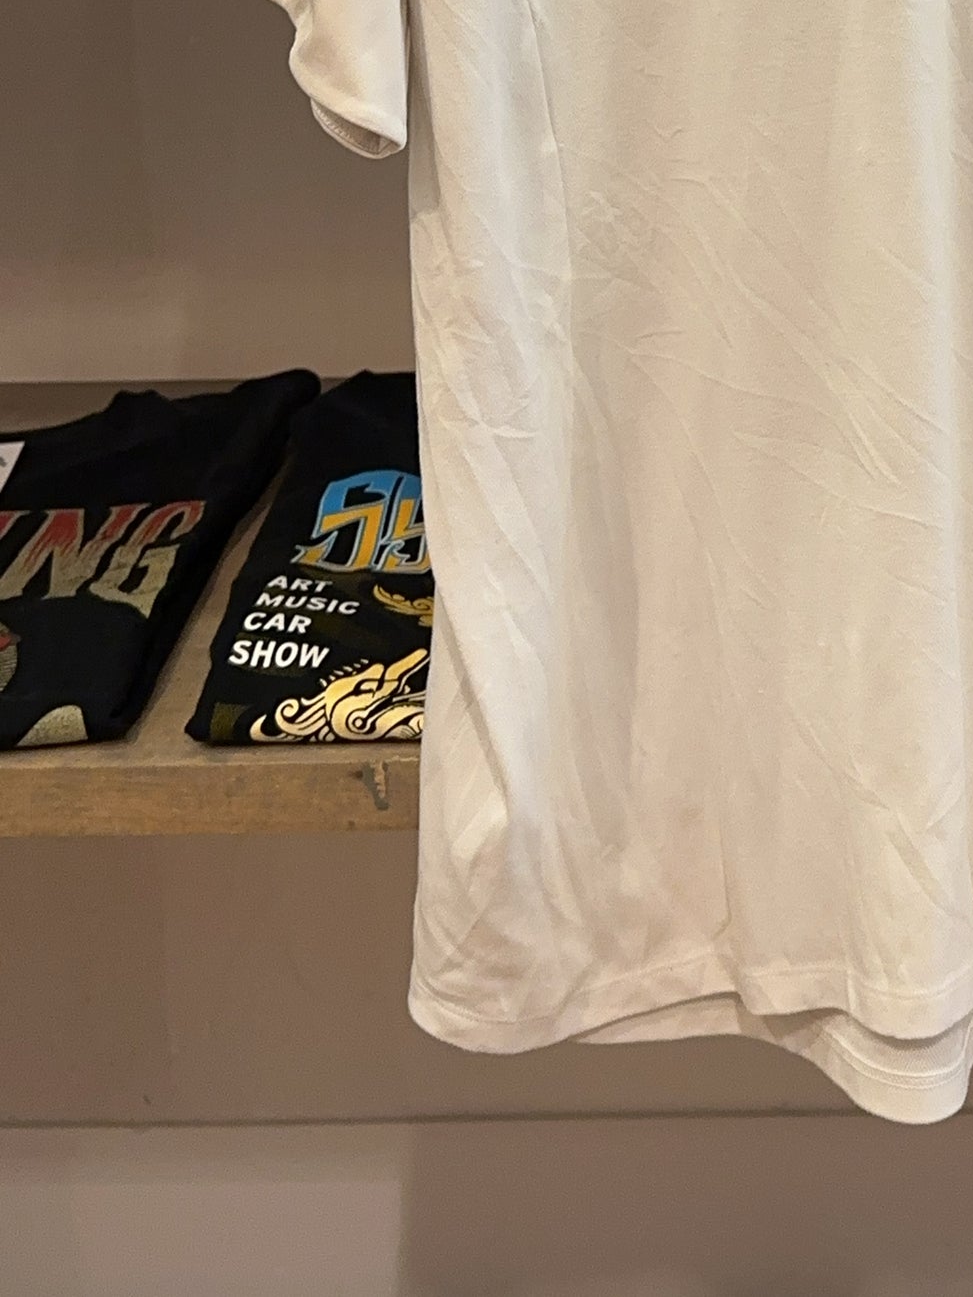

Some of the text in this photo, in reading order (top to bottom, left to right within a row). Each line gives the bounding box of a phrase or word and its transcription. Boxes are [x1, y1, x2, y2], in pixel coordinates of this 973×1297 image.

[267, 575, 333, 593] ART
[255, 592, 360, 614] MUSIC
[243, 612, 312, 634] CAR
[228, 640, 330, 669] SHOW
